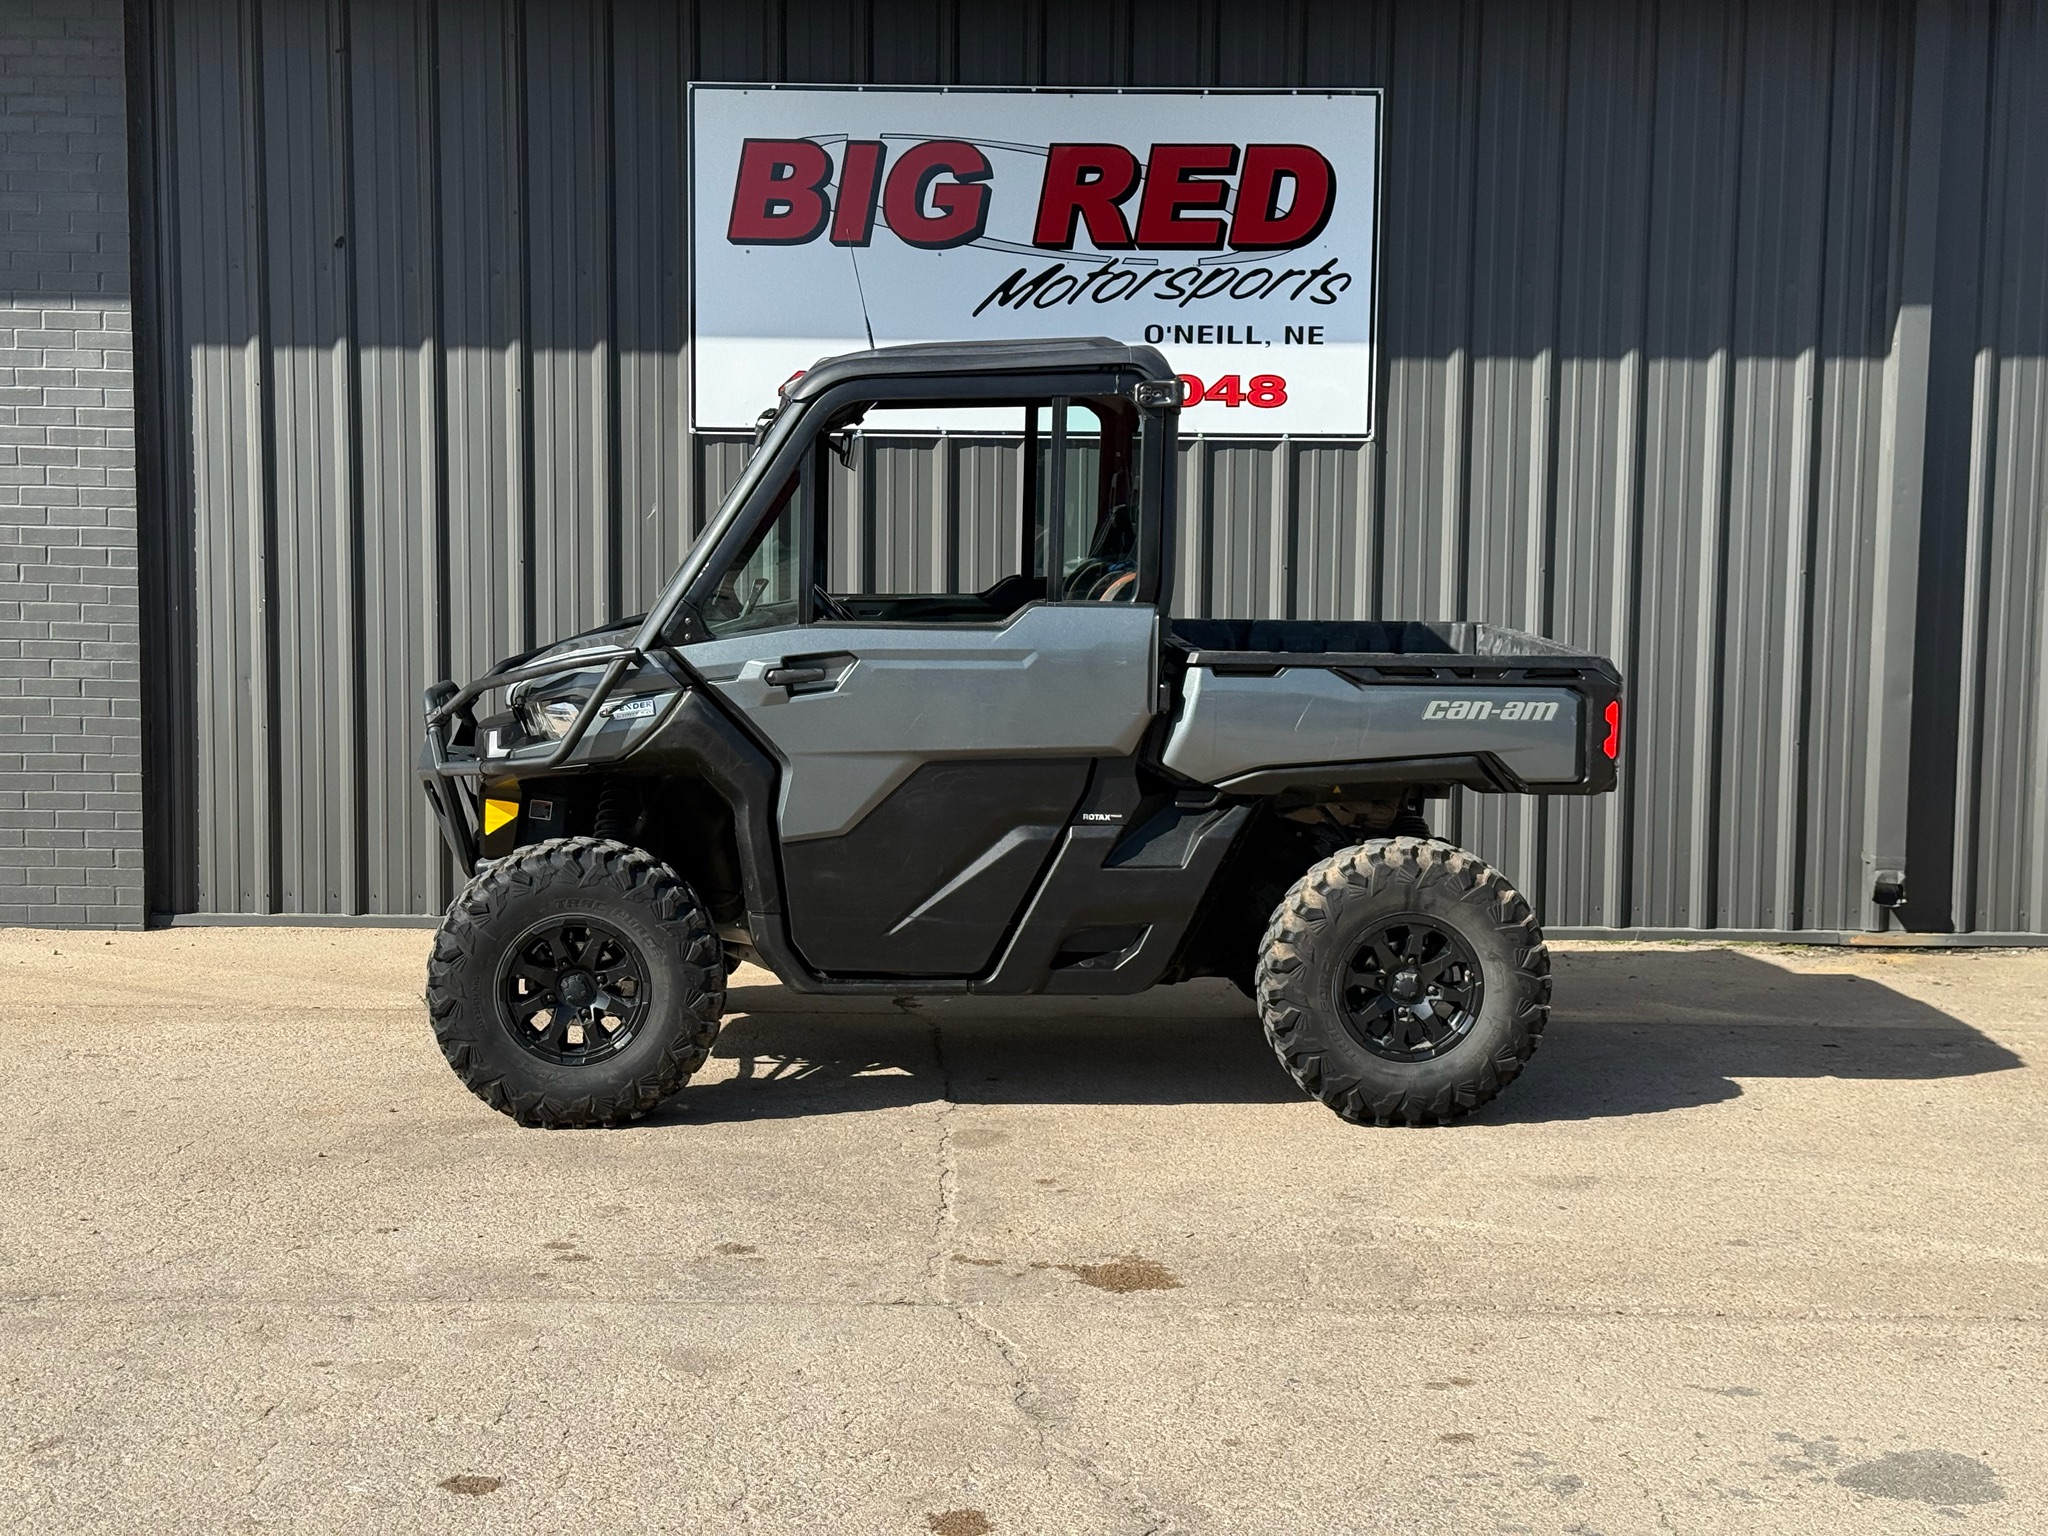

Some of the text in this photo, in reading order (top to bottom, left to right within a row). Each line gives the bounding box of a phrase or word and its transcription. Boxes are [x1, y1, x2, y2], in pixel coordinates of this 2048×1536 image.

[726, 138, 1337, 251] BIG RED
[972, 258, 1352, 317] Motorsports
[1144, 324, 1325, 348] O'NEILL, NE
[1422, 700, 1559, 721] can-am
[1082, 813, 1111, 821] ROTAX
